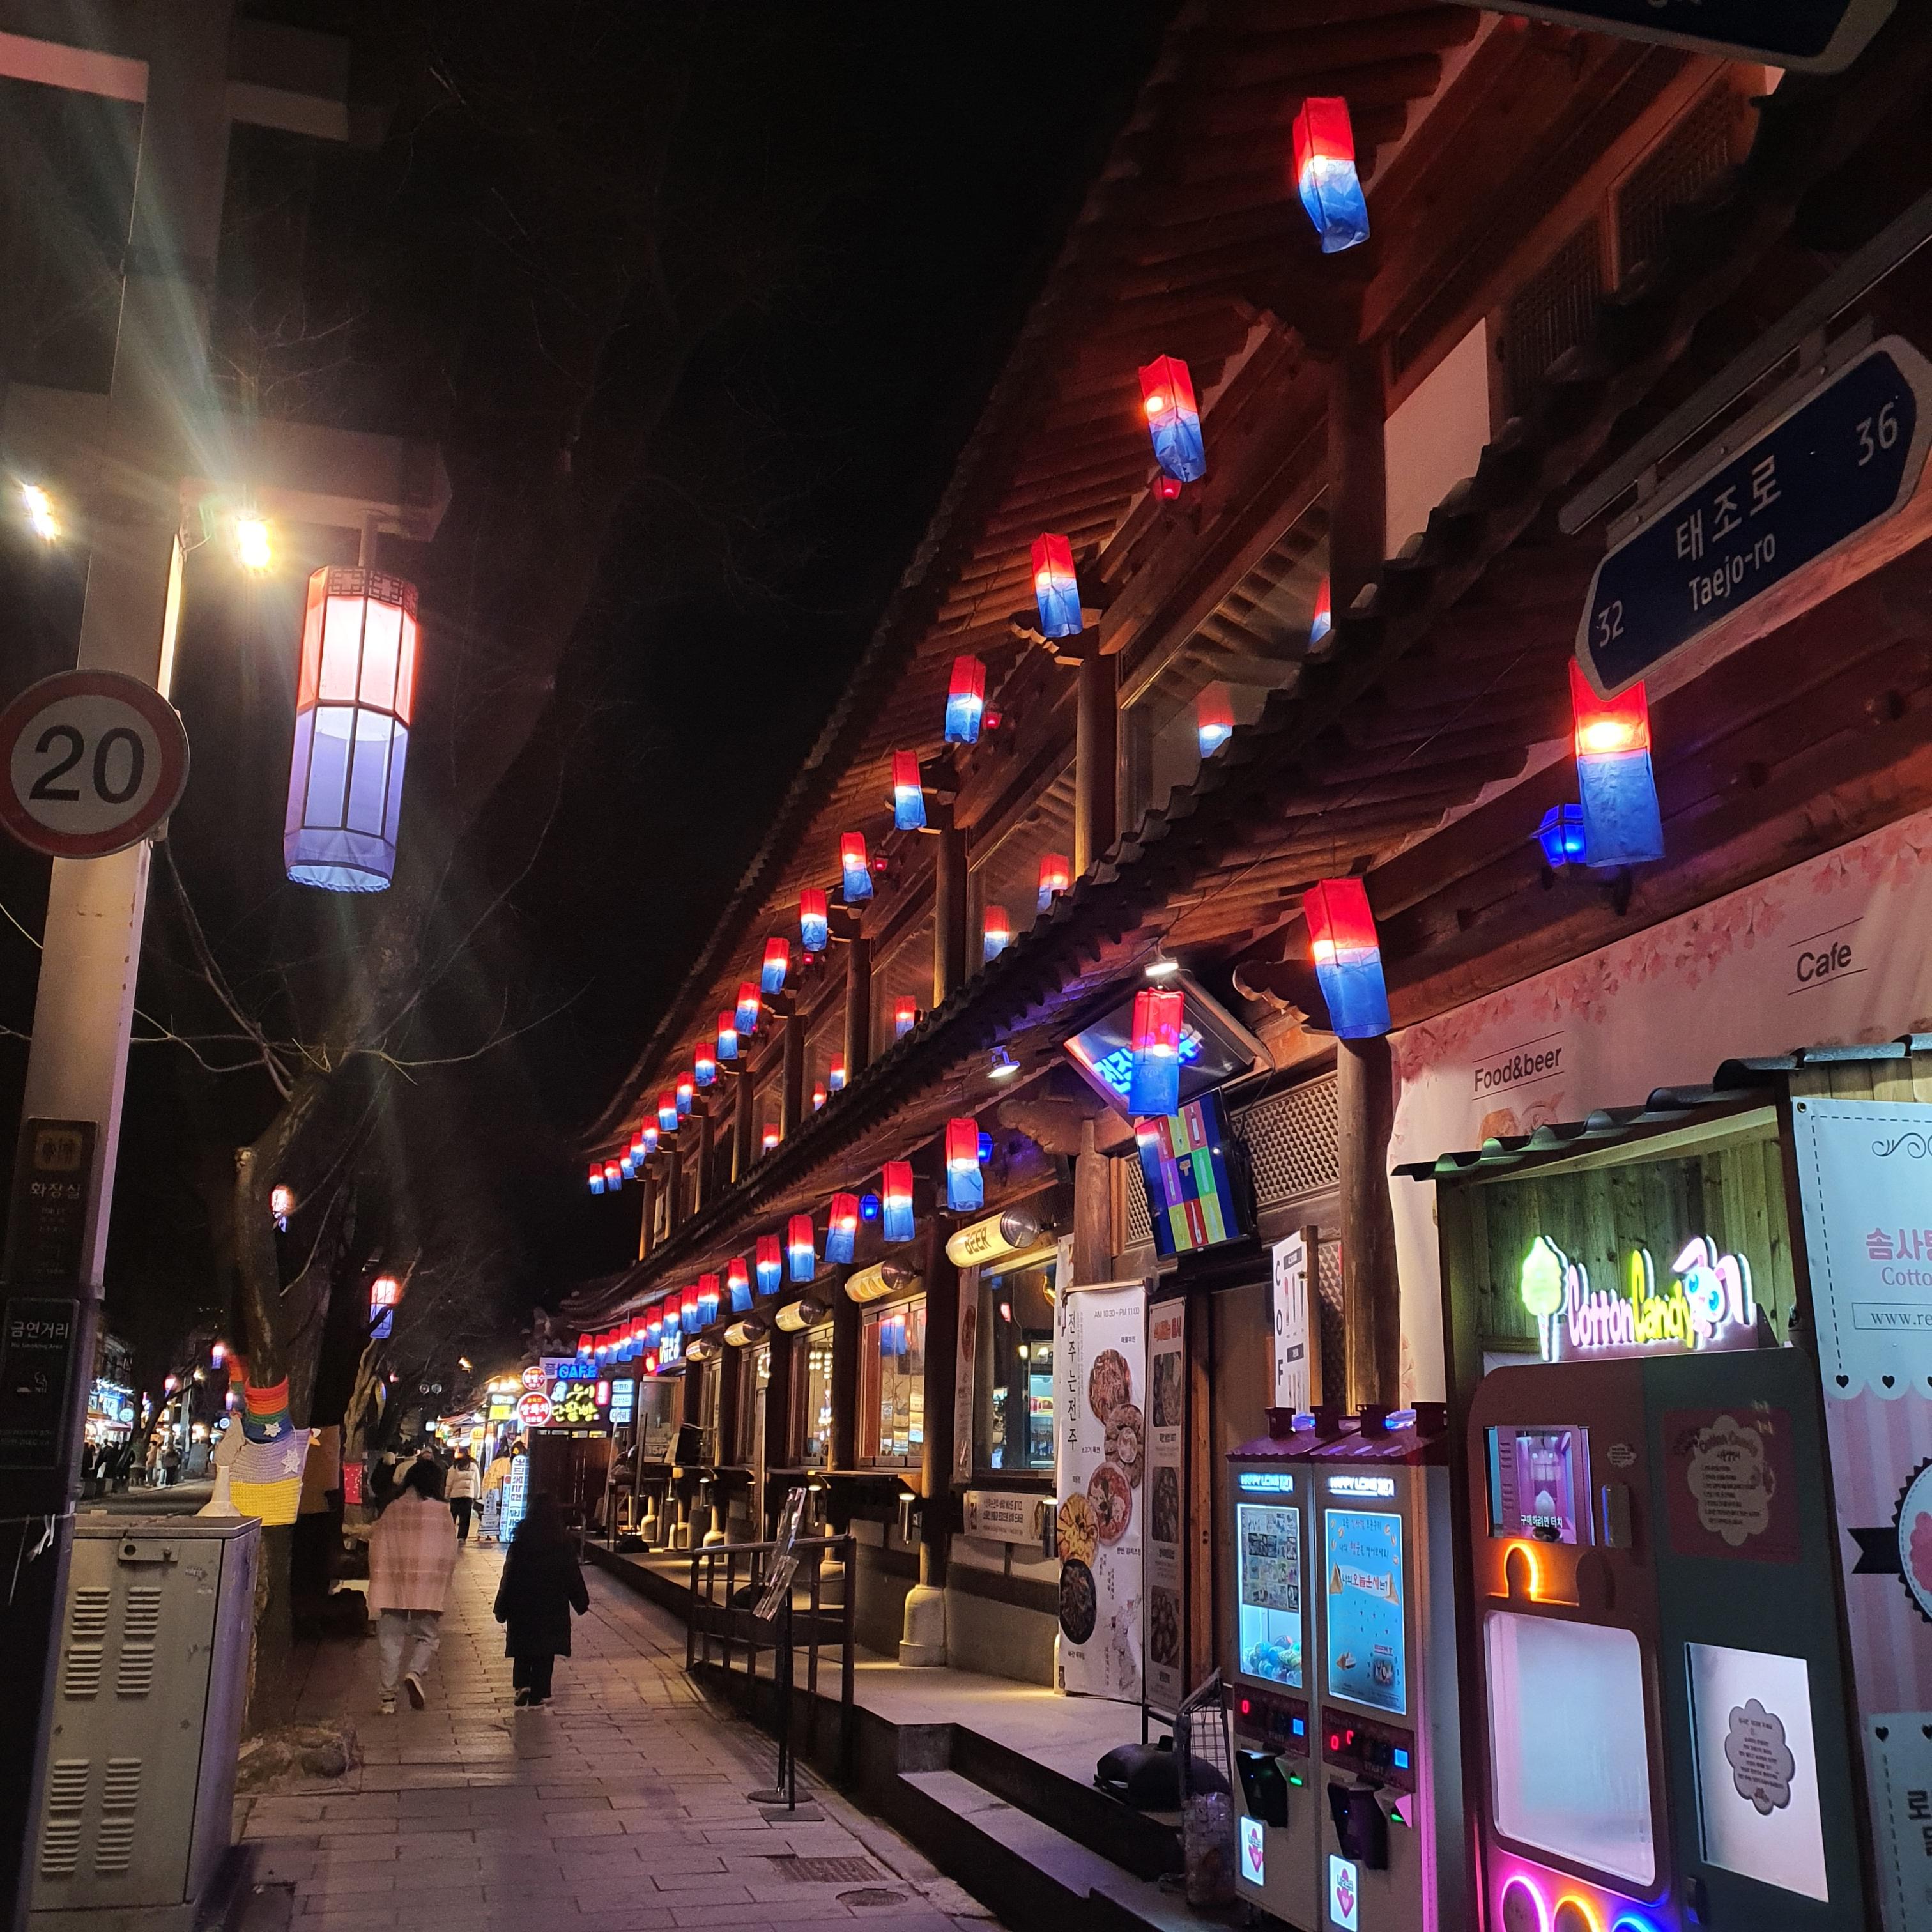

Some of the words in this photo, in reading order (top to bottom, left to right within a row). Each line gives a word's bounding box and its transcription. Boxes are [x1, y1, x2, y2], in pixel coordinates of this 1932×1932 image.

[1855, 401, 1898, 468] 36
[1676, 454, 1782, 562] 태조로
[1688, 533, 1776, 611] Taejo-ro
[1598, 601, 1624, 648] 32
[29, 724, 144, 804] 20
[1796, 941, 1852, 983] Cafe
[1473, 1045, 1563, 1092] Food&beer
[30, 1181, 81, 1200] 화장실
[964, 1226, 992, 1255] BEER
[1567, 1264, 1634, 1347] Cotton
[1631, 1249, 1695, 1349] Candy
[10, 1321, 70, 1339] 금연거리
[558, 1363, 598, 1379] CAFE
[1551, 1516, 1563, 1529] 터치
[1241, 1699, 1250, 1714] 0
[1331, 1735, 1339, 1751] 0
